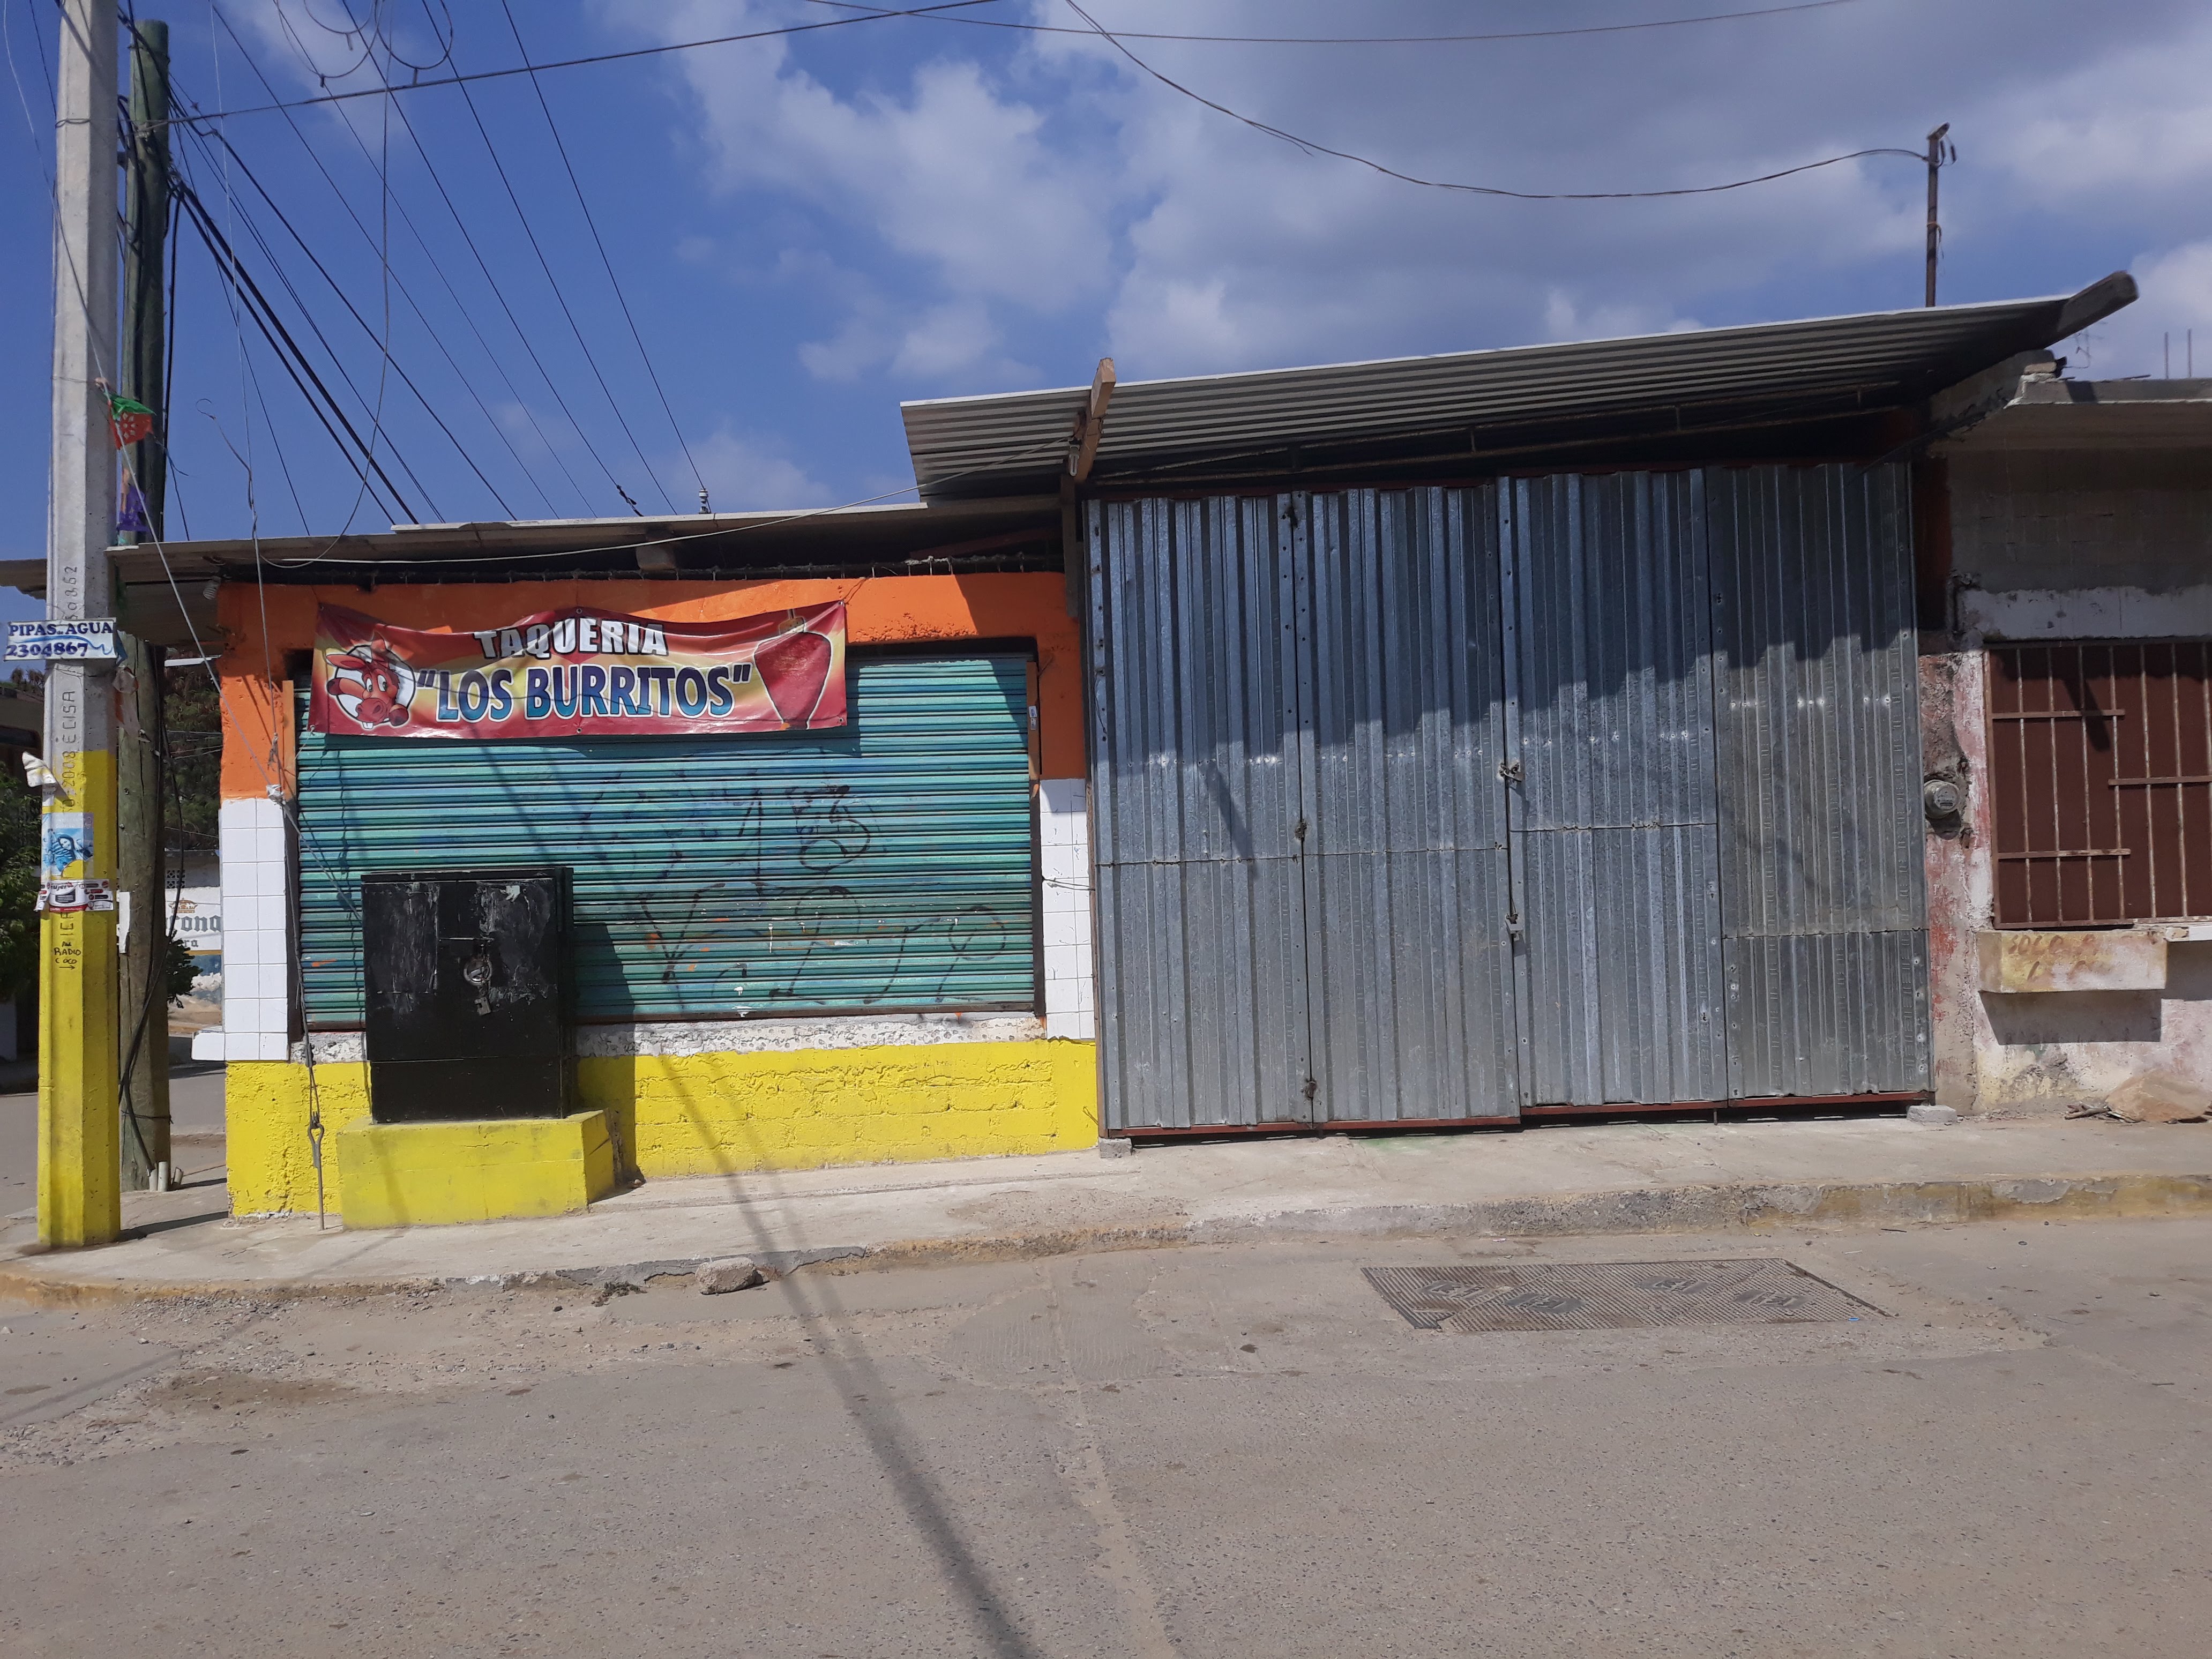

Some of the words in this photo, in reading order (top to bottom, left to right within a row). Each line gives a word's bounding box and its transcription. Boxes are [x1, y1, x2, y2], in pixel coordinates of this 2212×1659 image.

[9, 624, 57, 636] PIPAS
[65, 622, 113, 635] AGUA
[473, 617, 668, 660] TAQUERIA
[5, 642, 88, 657] 2304867
[416, 666, 513, 722] "LOS
[524, 662, 752, 720] BURRITOS"
[62, 691, 76, 743] ECISA
[166, 915, 221, 932] rona
